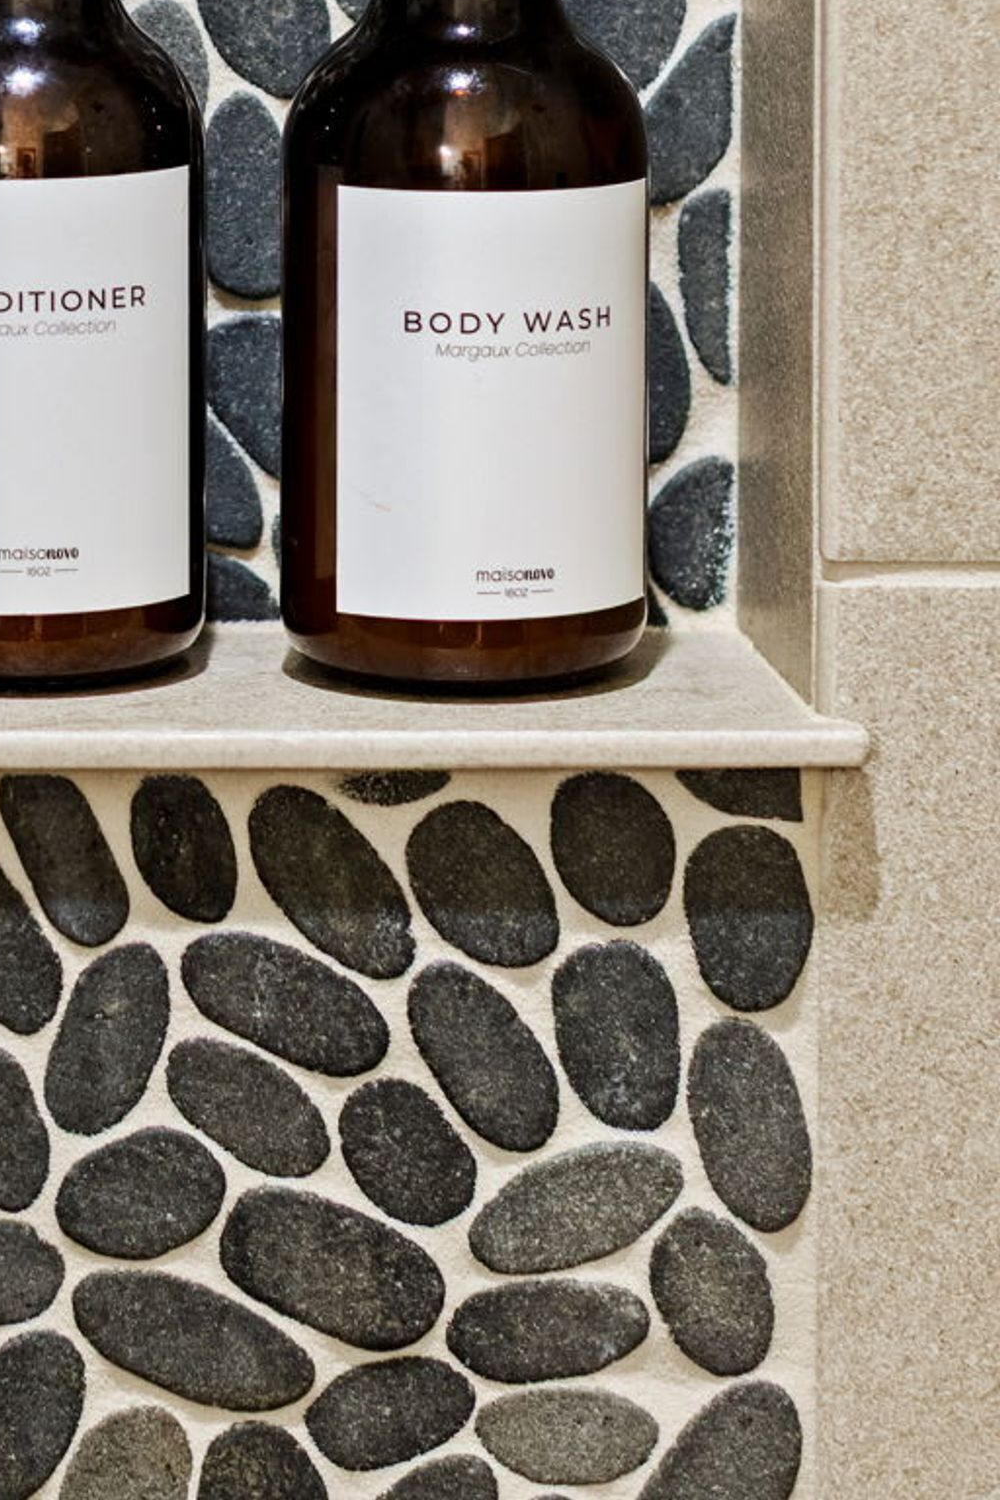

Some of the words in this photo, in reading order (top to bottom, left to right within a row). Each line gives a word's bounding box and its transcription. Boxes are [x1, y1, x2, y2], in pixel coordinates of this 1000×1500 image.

[33, 319, 117, 337] Collection
[403, 310, 505, 335] BODY
[522, 305, 611, 333] WASH
[435, 342, 510, 362] Margaux
[514, 340, 591, 358] Collection
